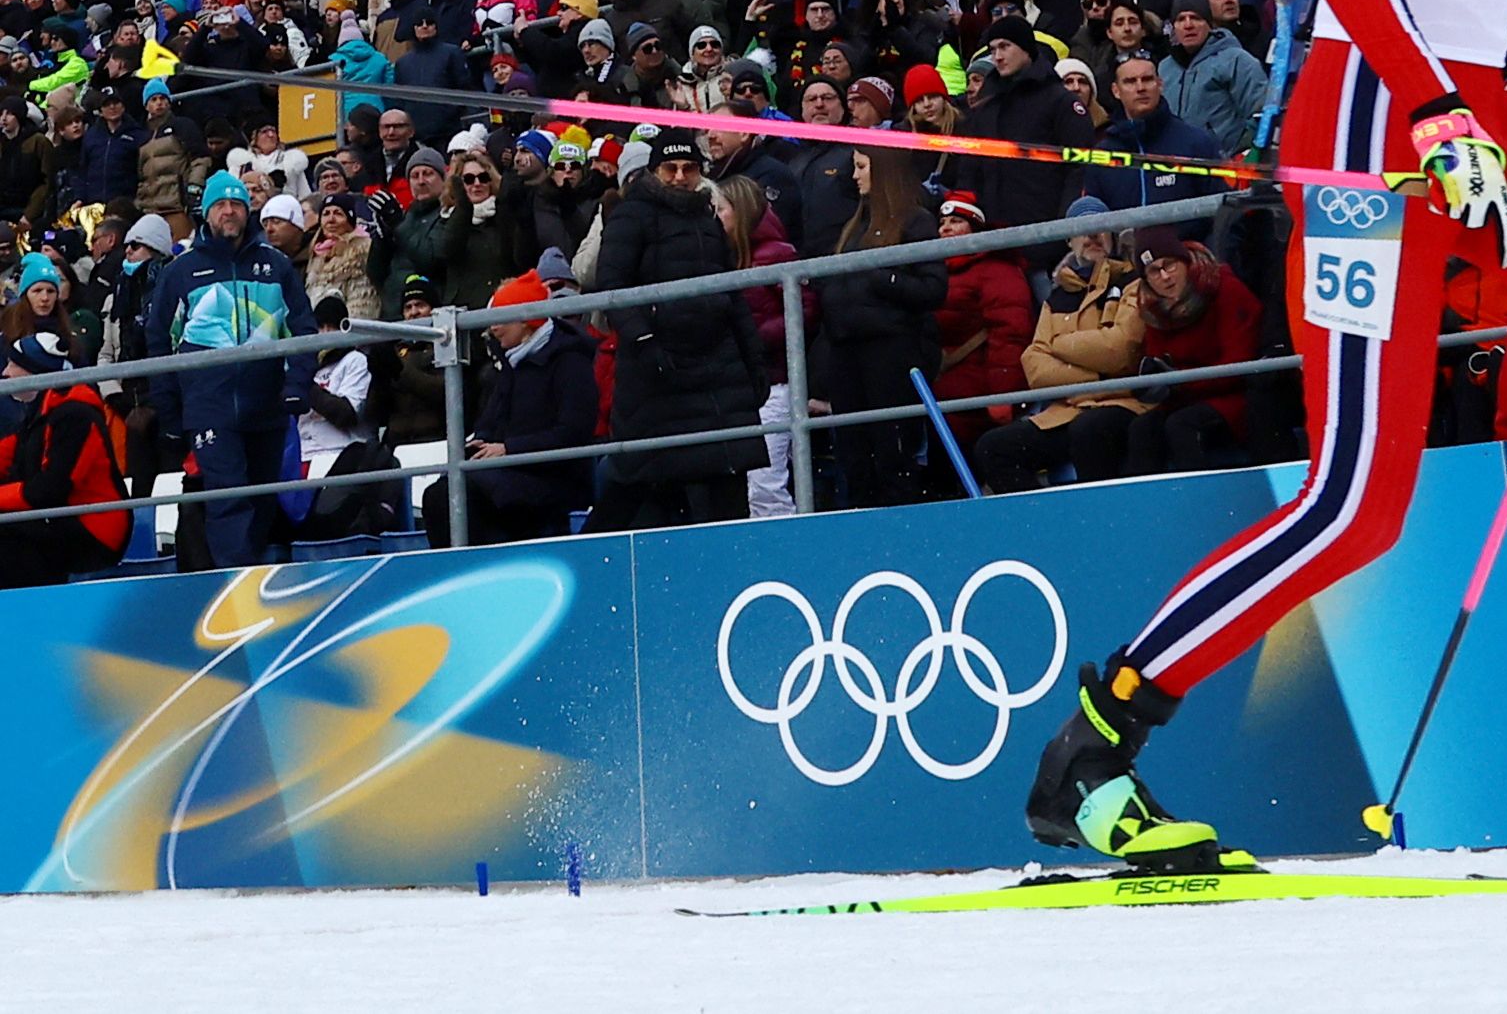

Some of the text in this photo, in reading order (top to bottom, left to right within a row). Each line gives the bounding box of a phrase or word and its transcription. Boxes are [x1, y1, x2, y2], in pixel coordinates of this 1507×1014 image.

[303, 93, 316, 120] F
[662, 143, 692, 155] CELINE
[1062, 147, 1133, 167] LEKI
[1315, 252, 1377, 309] 56
[1114, 877, 1221, 896] FISCHER
